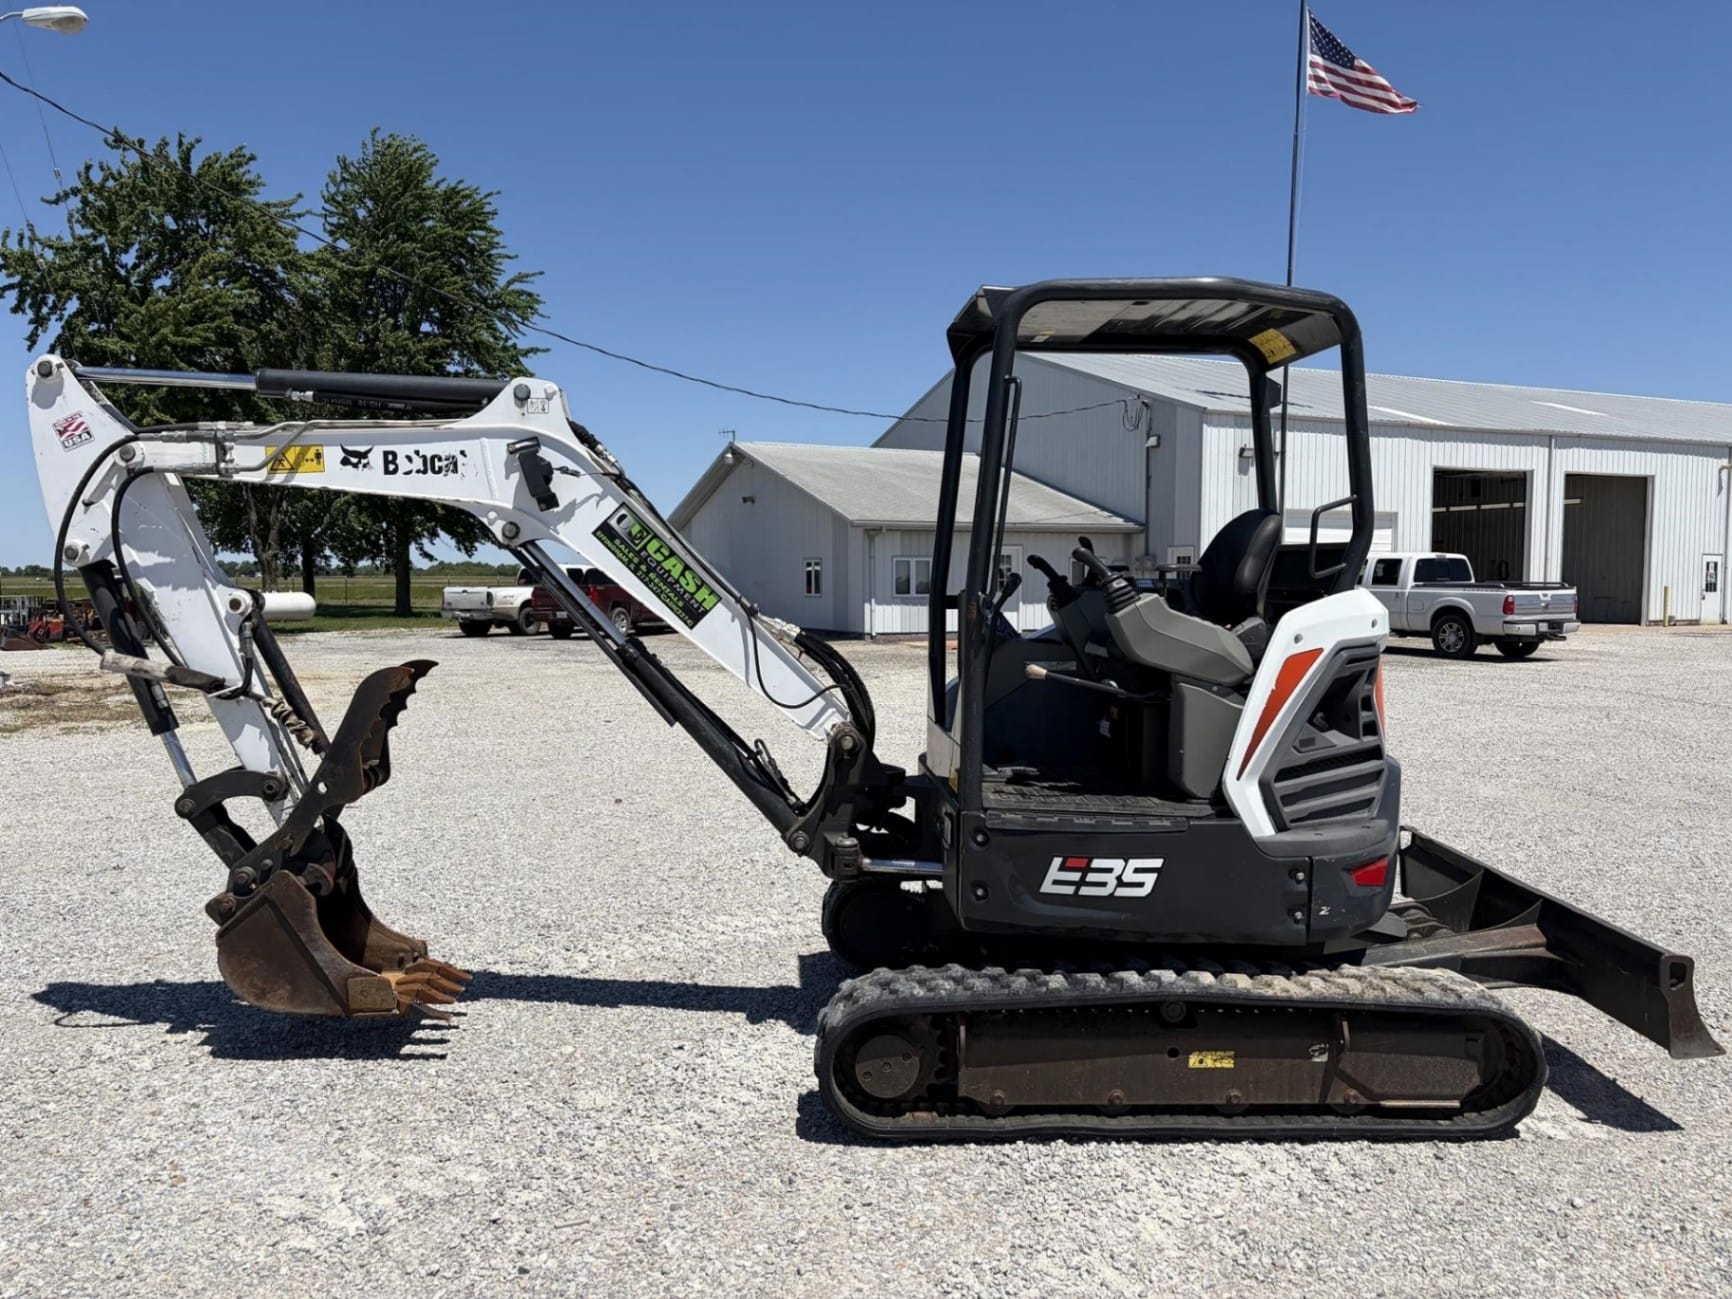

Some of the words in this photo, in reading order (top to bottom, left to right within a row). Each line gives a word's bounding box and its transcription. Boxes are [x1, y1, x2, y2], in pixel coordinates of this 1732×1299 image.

[64, 432, 91, 448] USA
[613, 538, 639, 564] SALES
[648, 572, 685, 607] RENTALS
[640, 550, 705, 614] EQUIPMENT
[645, 537, 720, 611] CASH
[1039, 857, 1165, 897] E35
